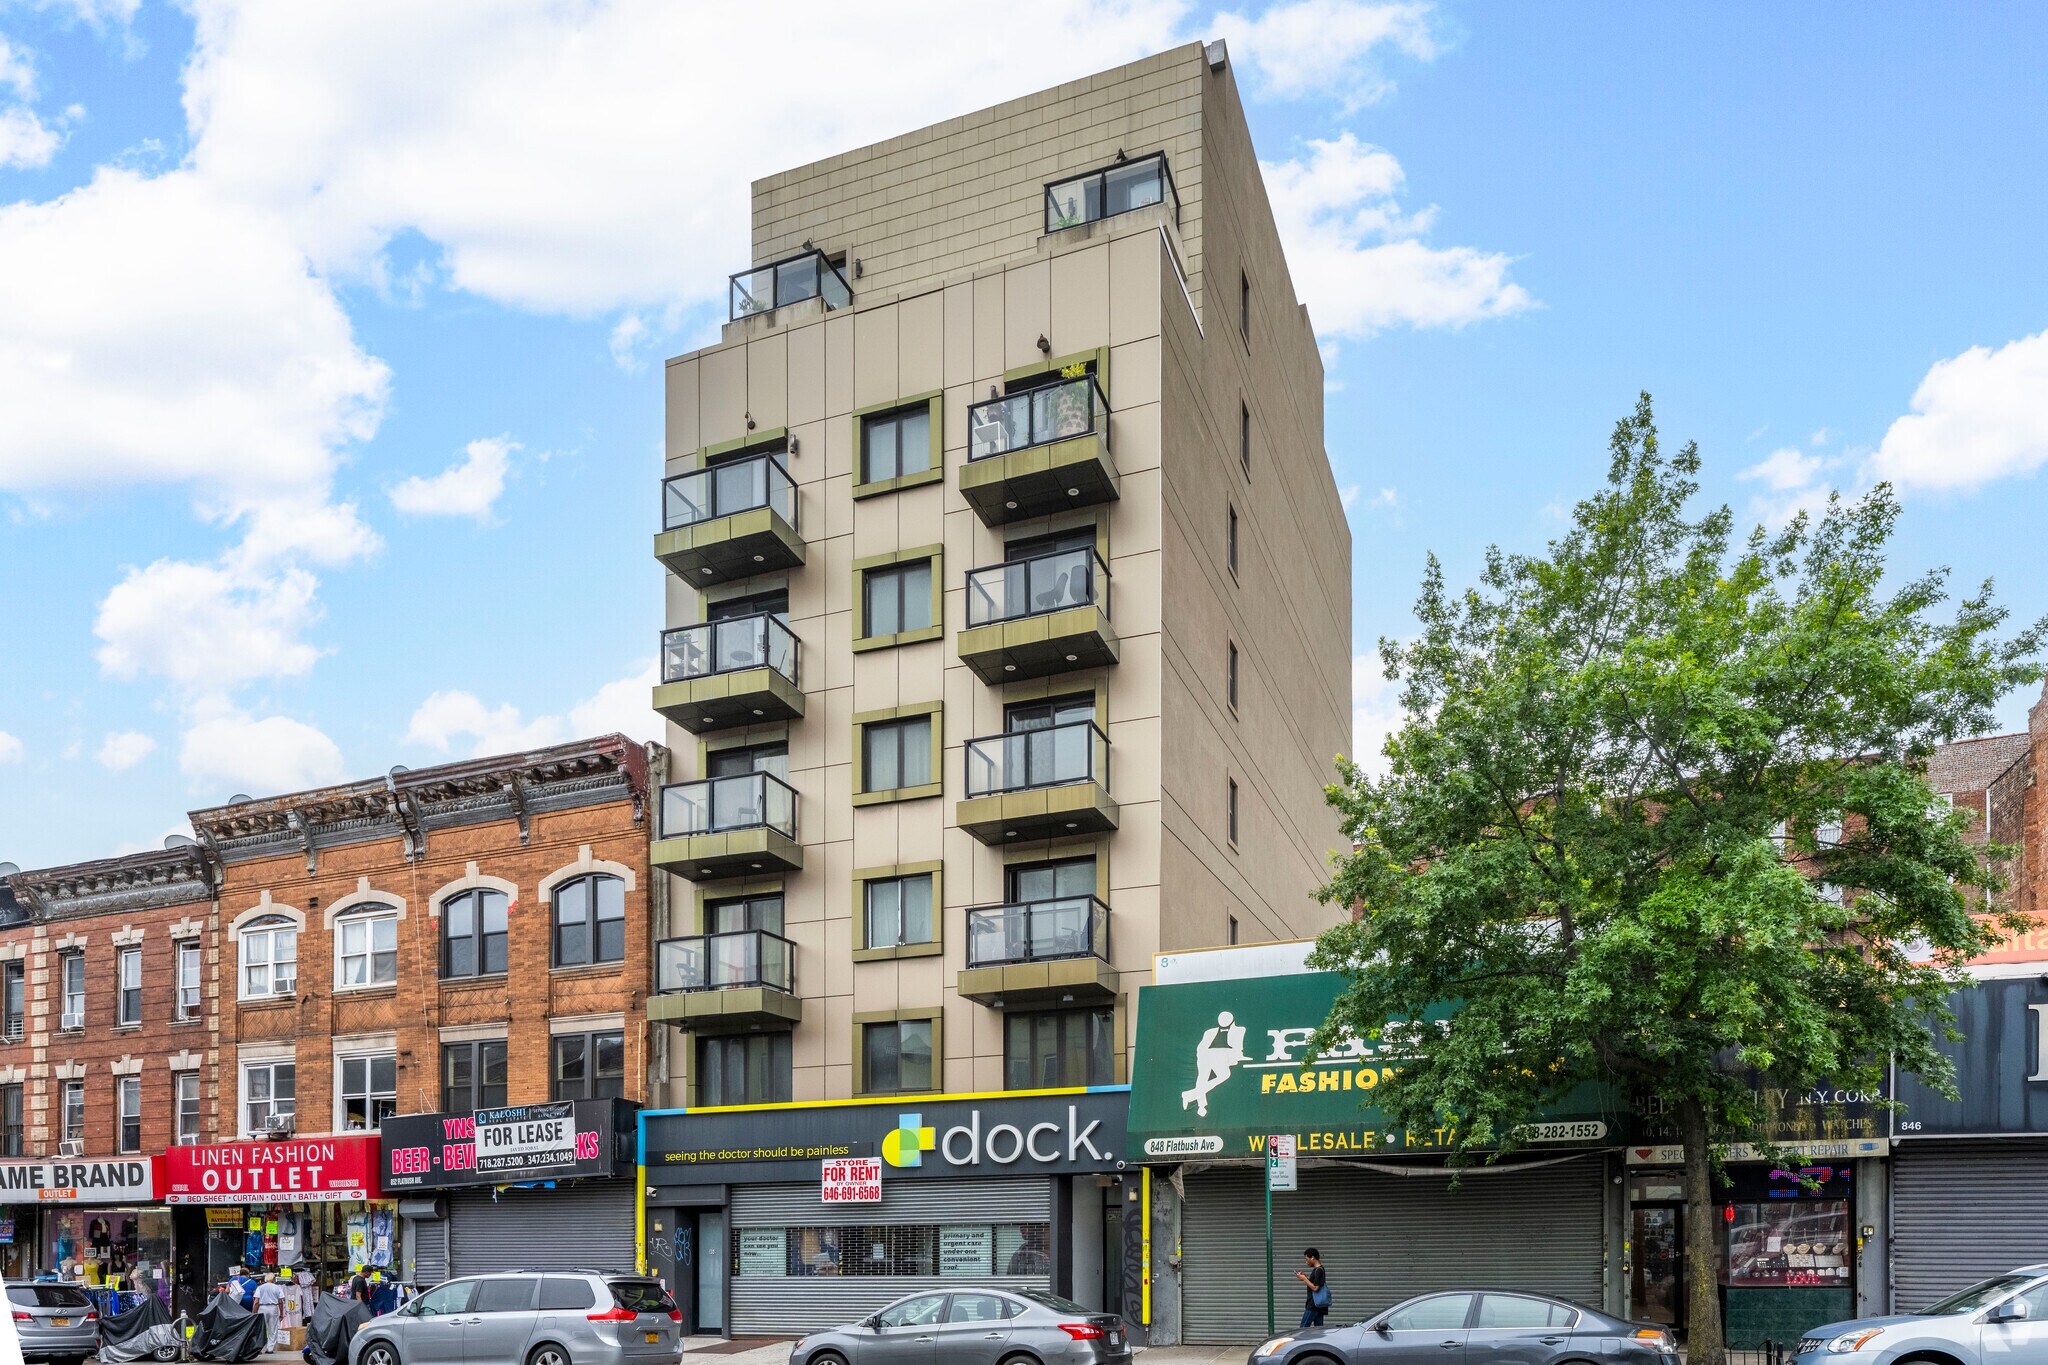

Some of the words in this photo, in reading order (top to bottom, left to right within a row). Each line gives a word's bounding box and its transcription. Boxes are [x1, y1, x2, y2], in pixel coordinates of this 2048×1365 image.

[489, 1108, 526, 1119] KALOSHI
[484, 1127, 512, 1147] FOR
[518, 1122, 563, 1144] LEASE
[1518, 1123, 1598, 1140] 8-282-1552
[1901, 1122, 1921, 1131] 846
[1151, 1138, 1165, 1152] 848
[1166, 1137, 1199, 1152] Flatbush
[1200, 1137, 1215, 1151] Ave
[1249, 1131, 1375, 1152] WLESALE
[1810, 1144, 1848, 1155] REPAIR
[192, 1149, 243, 1166] LINEN
[252, 1144, 334, 1164] FASHION
[392, 1147, 430, 1174] BEER
[480, 1156, 524, 1169] 718.287.5200
[528, 1151, 573, 1165] 347.234.1049
[665, 1151, 697, 1162] seeing
[699, 1150, 716, 1160] the
[718, 1149, 751, 1160] doctor
[753, 1147, 788, 1158] should
[790, 1146, 804, 1157] be
[806, 1145, 849, 1158] painless
[53, 1163, 144, 1188] BRAND
[202, 1166, 323, 1191] OUTLET
[824, 1167, 846, 1181] FOR
[850, 1166, 880, 1181] RENT
[43, 1189, 72, 1197] OUTLET
[233, 1194, 264, 1202] CURTAIN
[298, 1192, 318, 1200] BATH
[324, 1191, 342, 1199] GIFT
[824, 1186, 880, 1200] 646-691-6568
